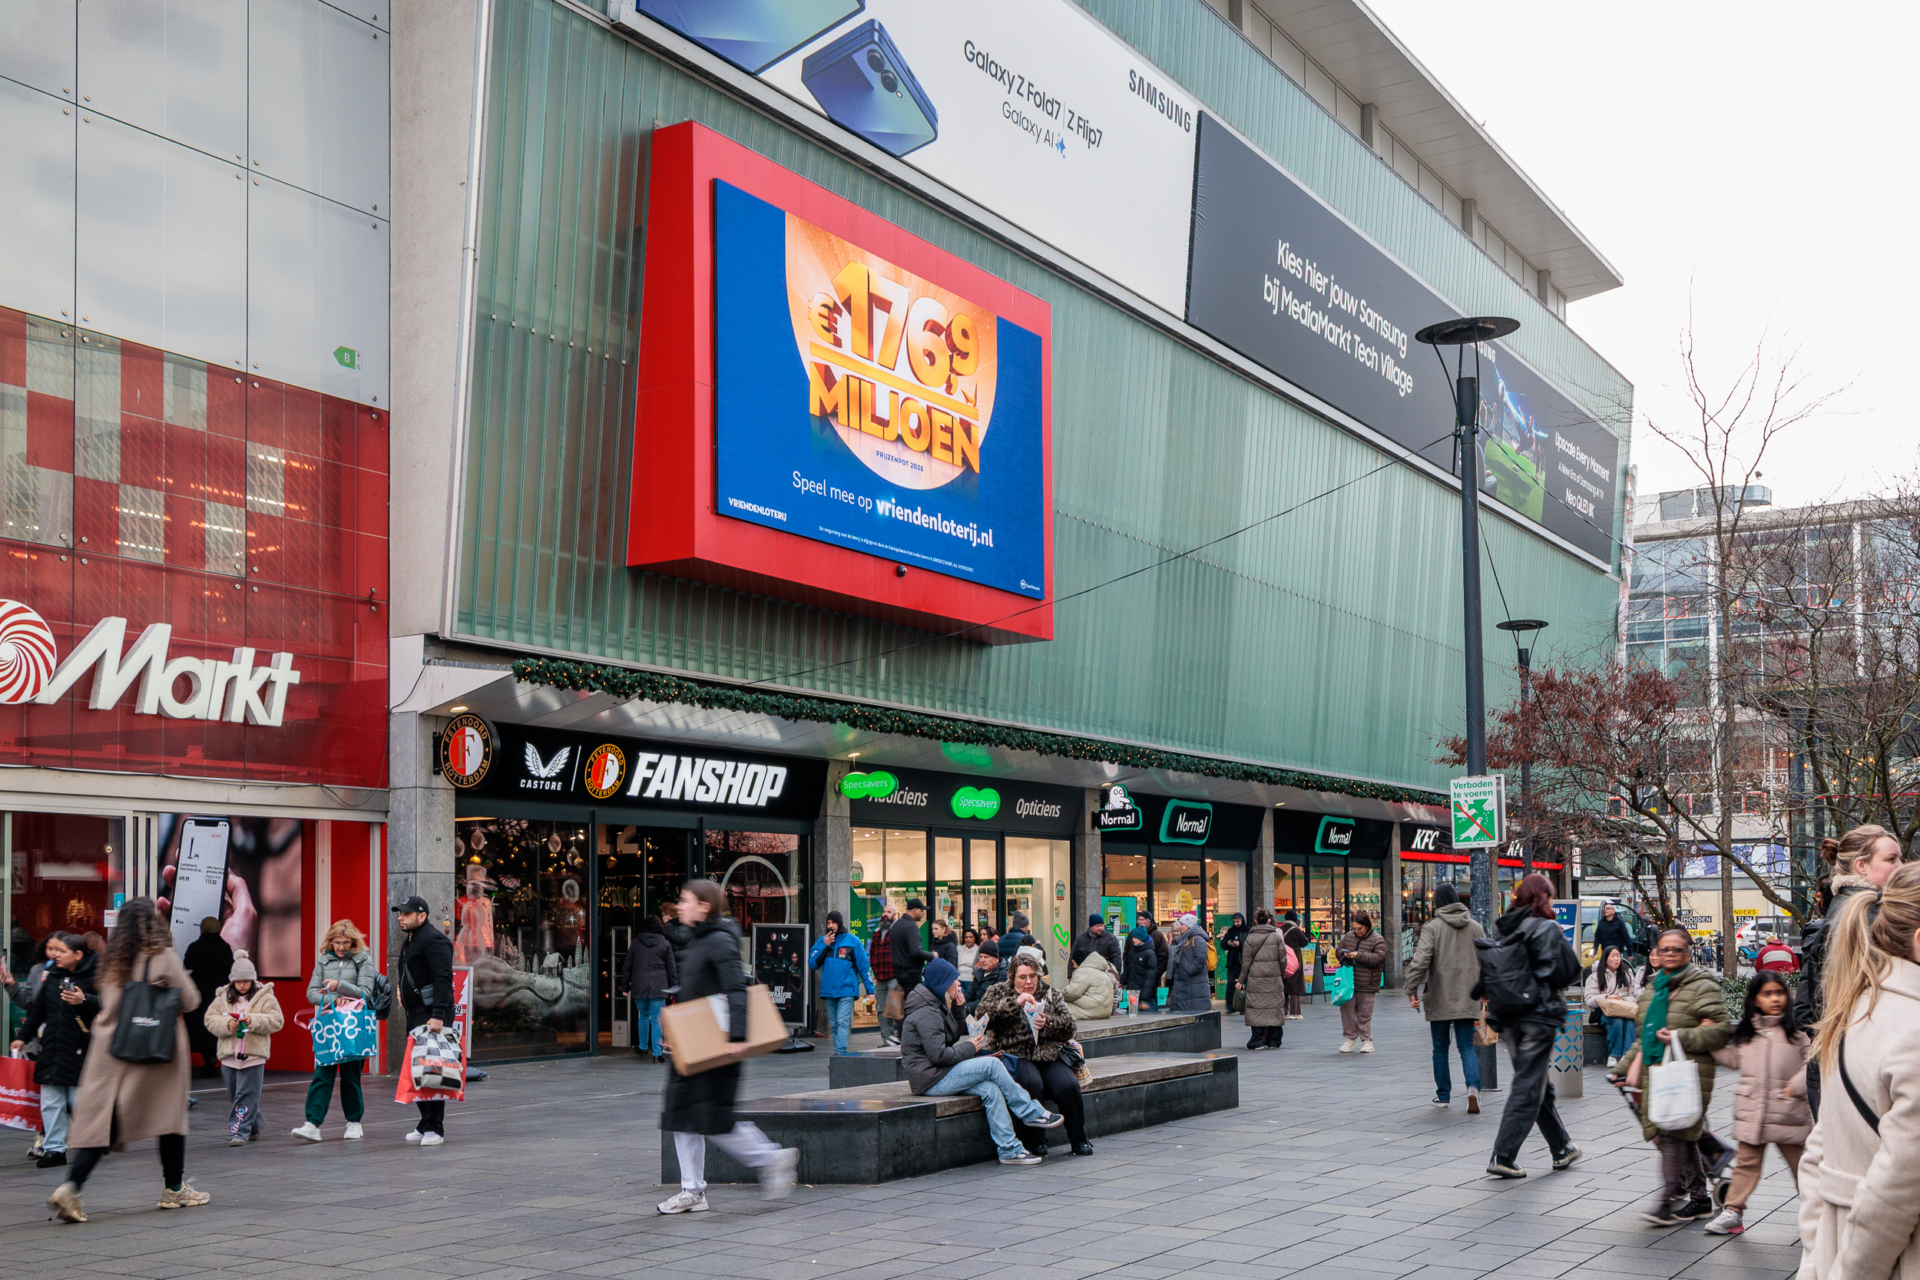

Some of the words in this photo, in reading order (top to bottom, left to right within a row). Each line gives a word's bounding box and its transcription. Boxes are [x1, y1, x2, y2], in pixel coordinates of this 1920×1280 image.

[964, 39, 1015, 94] Galaxy
[1016, 74, 1025, 98] Z
[1027, 81, 1061, 120] Fold7
[1066, 109, 1075, 131] Z
[1077, 115, 1103, 149] Flip7
[1129, 69, 1191, 133] SAMSUNG
[1002, 101, 1042, 144] Galaxy
[1043, 129, 1054, 148] AI
[1277, 239, 1303, 279] Kies
[1305, 259, 1328, 295] hier
[1328, 275, 1358, 317] jouw
[1359, 299, 1407, 359] Samsung
[1263, 274, 1280, 315] bij
[1281, 286, 1351, 354] MediaMarkt
[1354, 334, 1379, 372] Tech
[1380, 352, 1413, 397] Village
[344, 352, 351, 363] B
[809, 361, 980, 474] MILJOEN
[876, 450, 909, 469] PRIJZENPOT
[910, 462, 924, 472] 2026
[1555, 431, 1576, 458] Upscale
[1576, 446, 1590, 472] Every
[1590, 456, 1610, 482] Moment
[1566, 487, 1576, 507] Neo
[1580, 476, 1596, 497] Samsung
[728, 497, 787, 522] VRIENDENLOTERIJ
[792, 470, 827, 496] Speel
[830, 486, 855, 505] mee
[857, 495, 873, 513] op
[876, 498, 994, 548] vriendenloterij.nl
[36, 616, 300, 728] Markt
[445, 715, 488, 743] FEYENOORD
[591, 746, 624, 766] FEYENOORD
[445, 759, 488, 785] ROTTERDAM
[626, 752, 788, 807] FANSHOP
[519, 779, 562, 791] CASTORE
[587, 777, 620, 797] ROTTERDAM
[843, 779, 888, 791] Specsavers
[1453, 781, 1493, 790] Verboden
[1464, 790, 1493, 798] voeren
[959, 796, 997, 809] Specsavers
[1016, 798, 1061, 819] Opticiens
[1101, 812, 1135, 826] Normal
[1176, 813, 1208, 833] Normal
[1328, 826, 1352, 845] Normal
[1411, 828, 1440, 851] KFC
